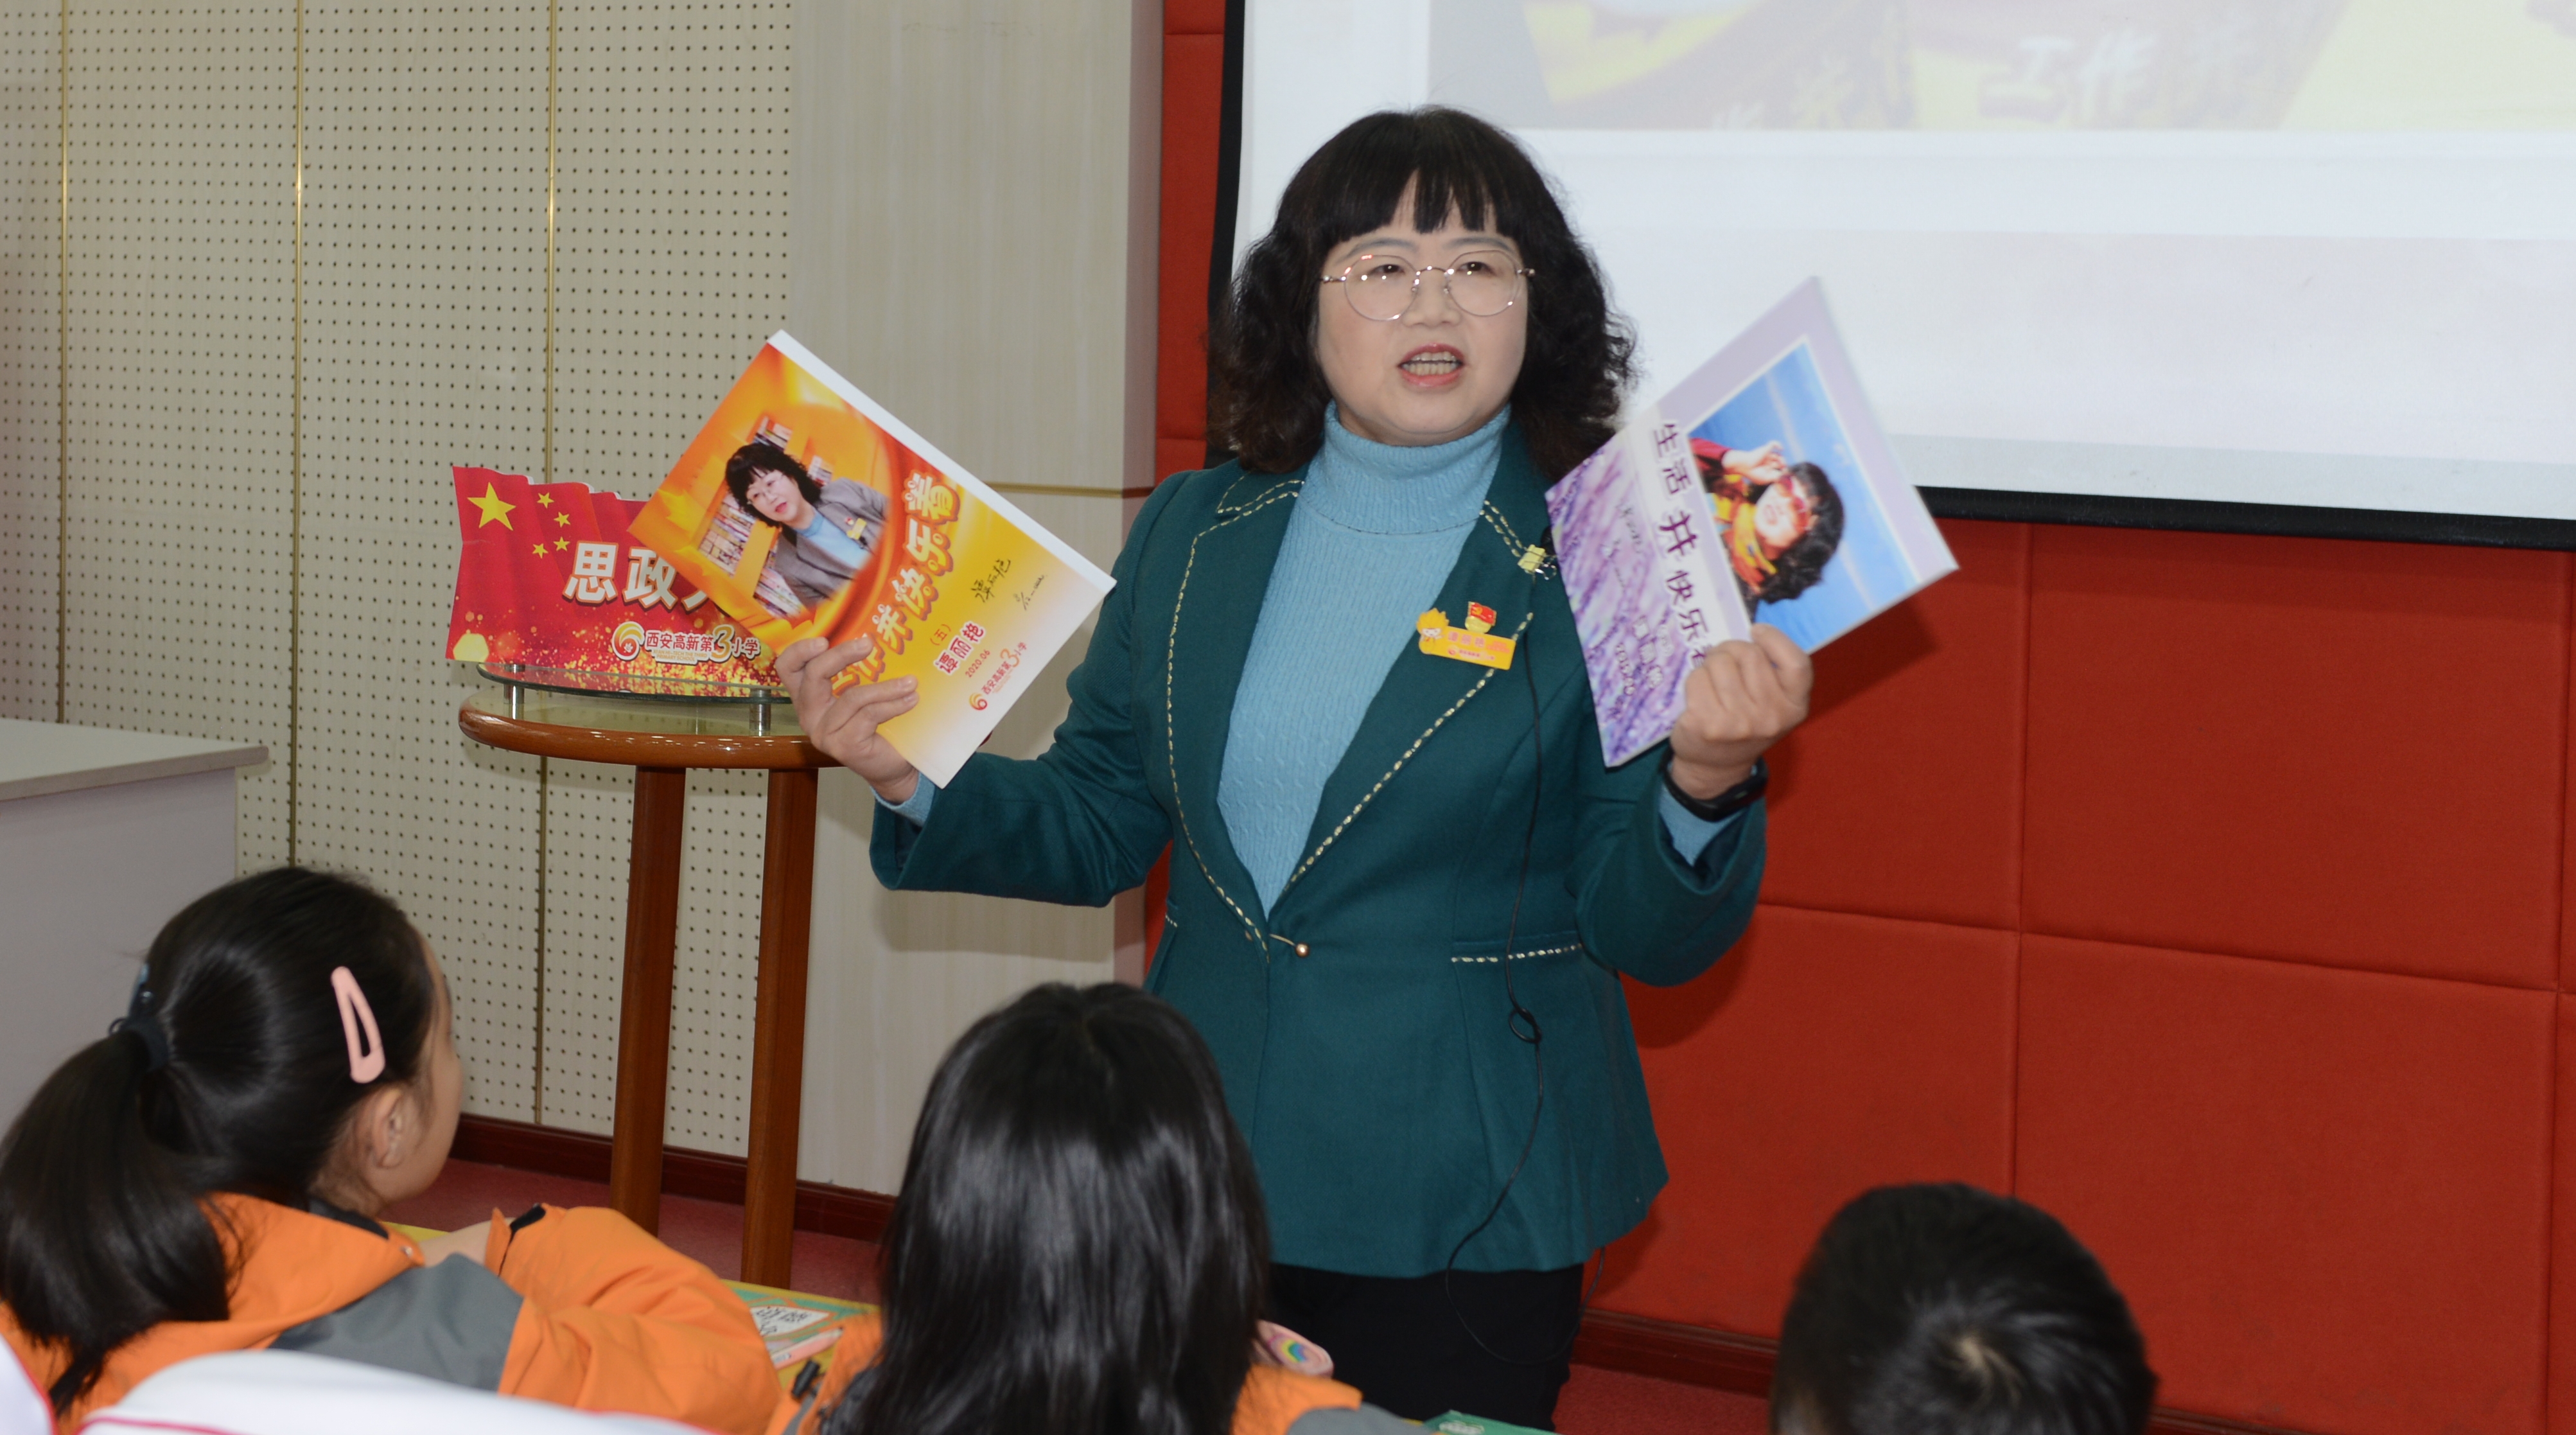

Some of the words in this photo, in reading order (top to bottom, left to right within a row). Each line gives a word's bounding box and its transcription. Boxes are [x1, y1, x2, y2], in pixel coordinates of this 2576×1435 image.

[563, 540, 708, 610] 思政
[646, 625, 758, 660] 西安高新第3小学
[934, 622, 984, 674] 谭丽艳
[965, 649, 991, 678] 2020.06
